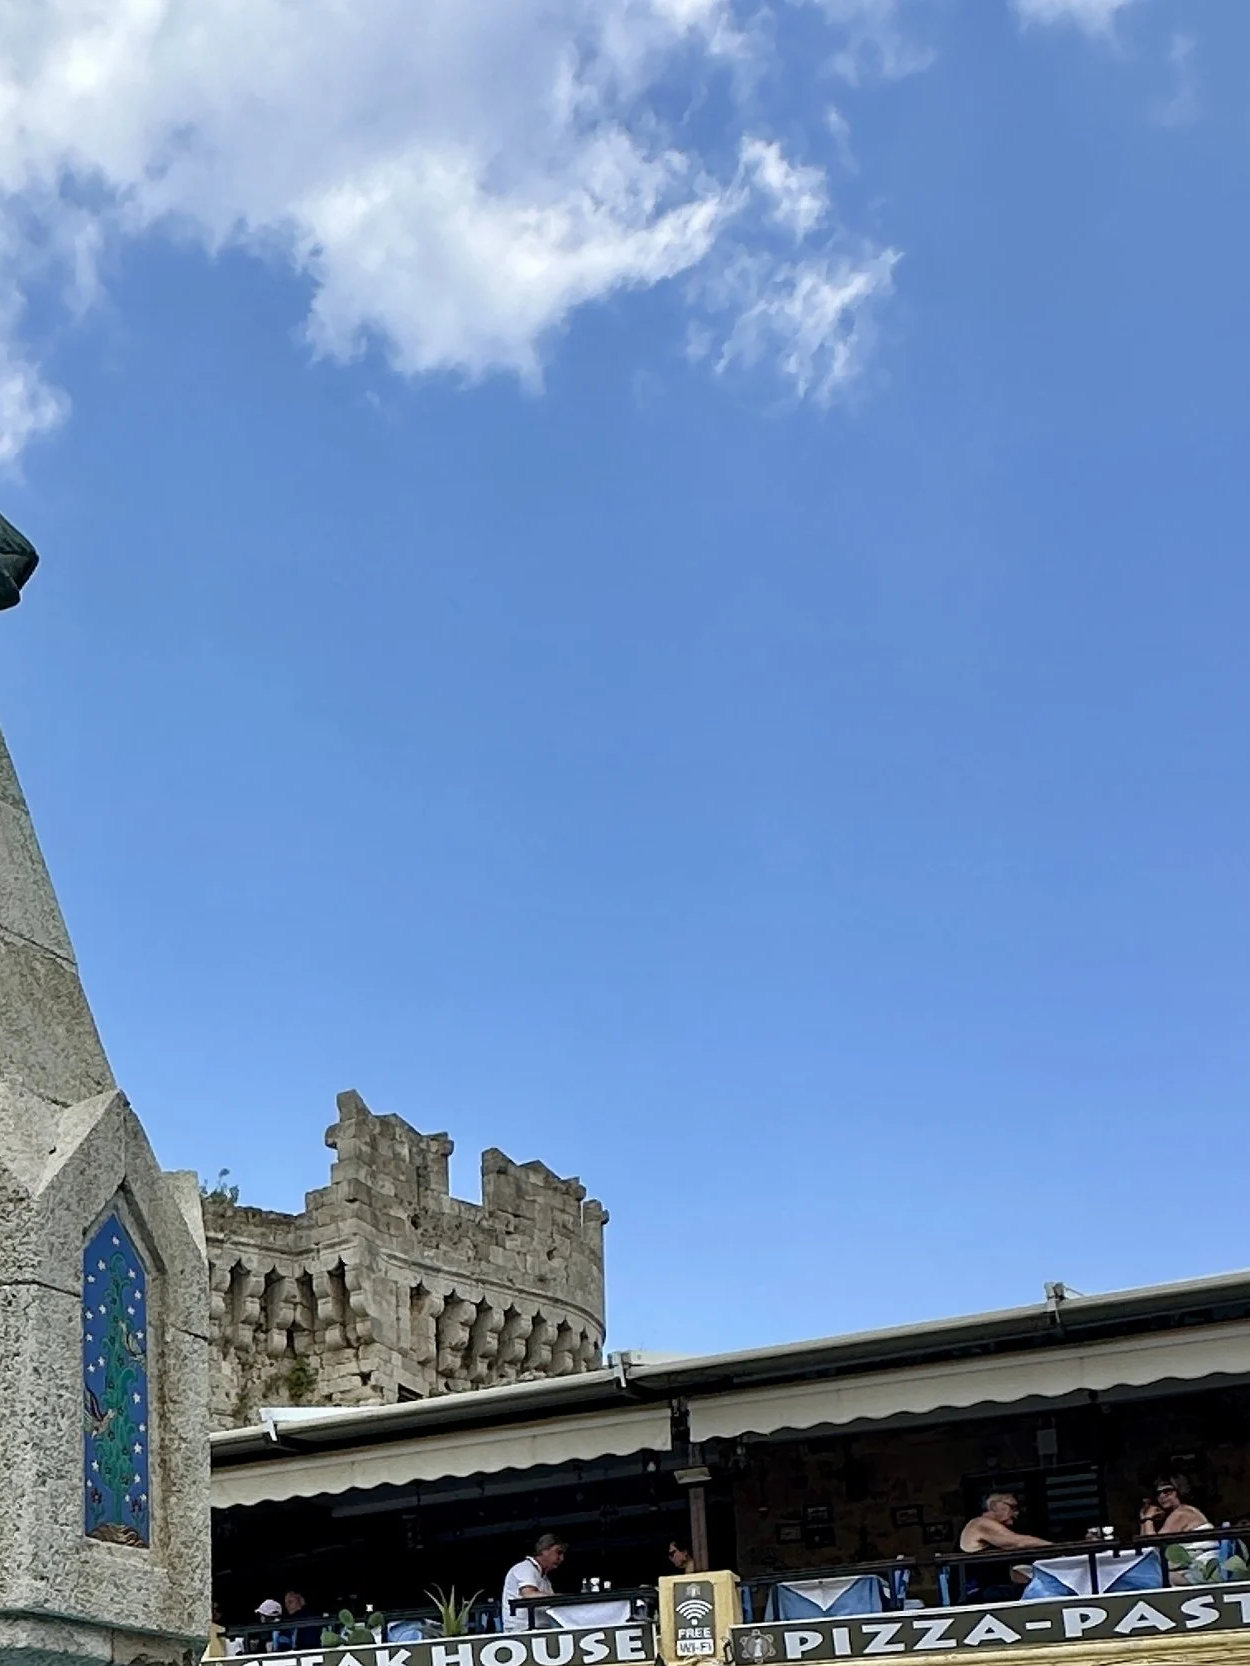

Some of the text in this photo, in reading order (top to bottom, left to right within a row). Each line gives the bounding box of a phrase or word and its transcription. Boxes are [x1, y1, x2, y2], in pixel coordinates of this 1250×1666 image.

[784, 1593, 1250, 1660] PIZZA-PAST
[678, 1628, 711, 1638] FREE
[680, 1641, 711, 1652] WI-FI
